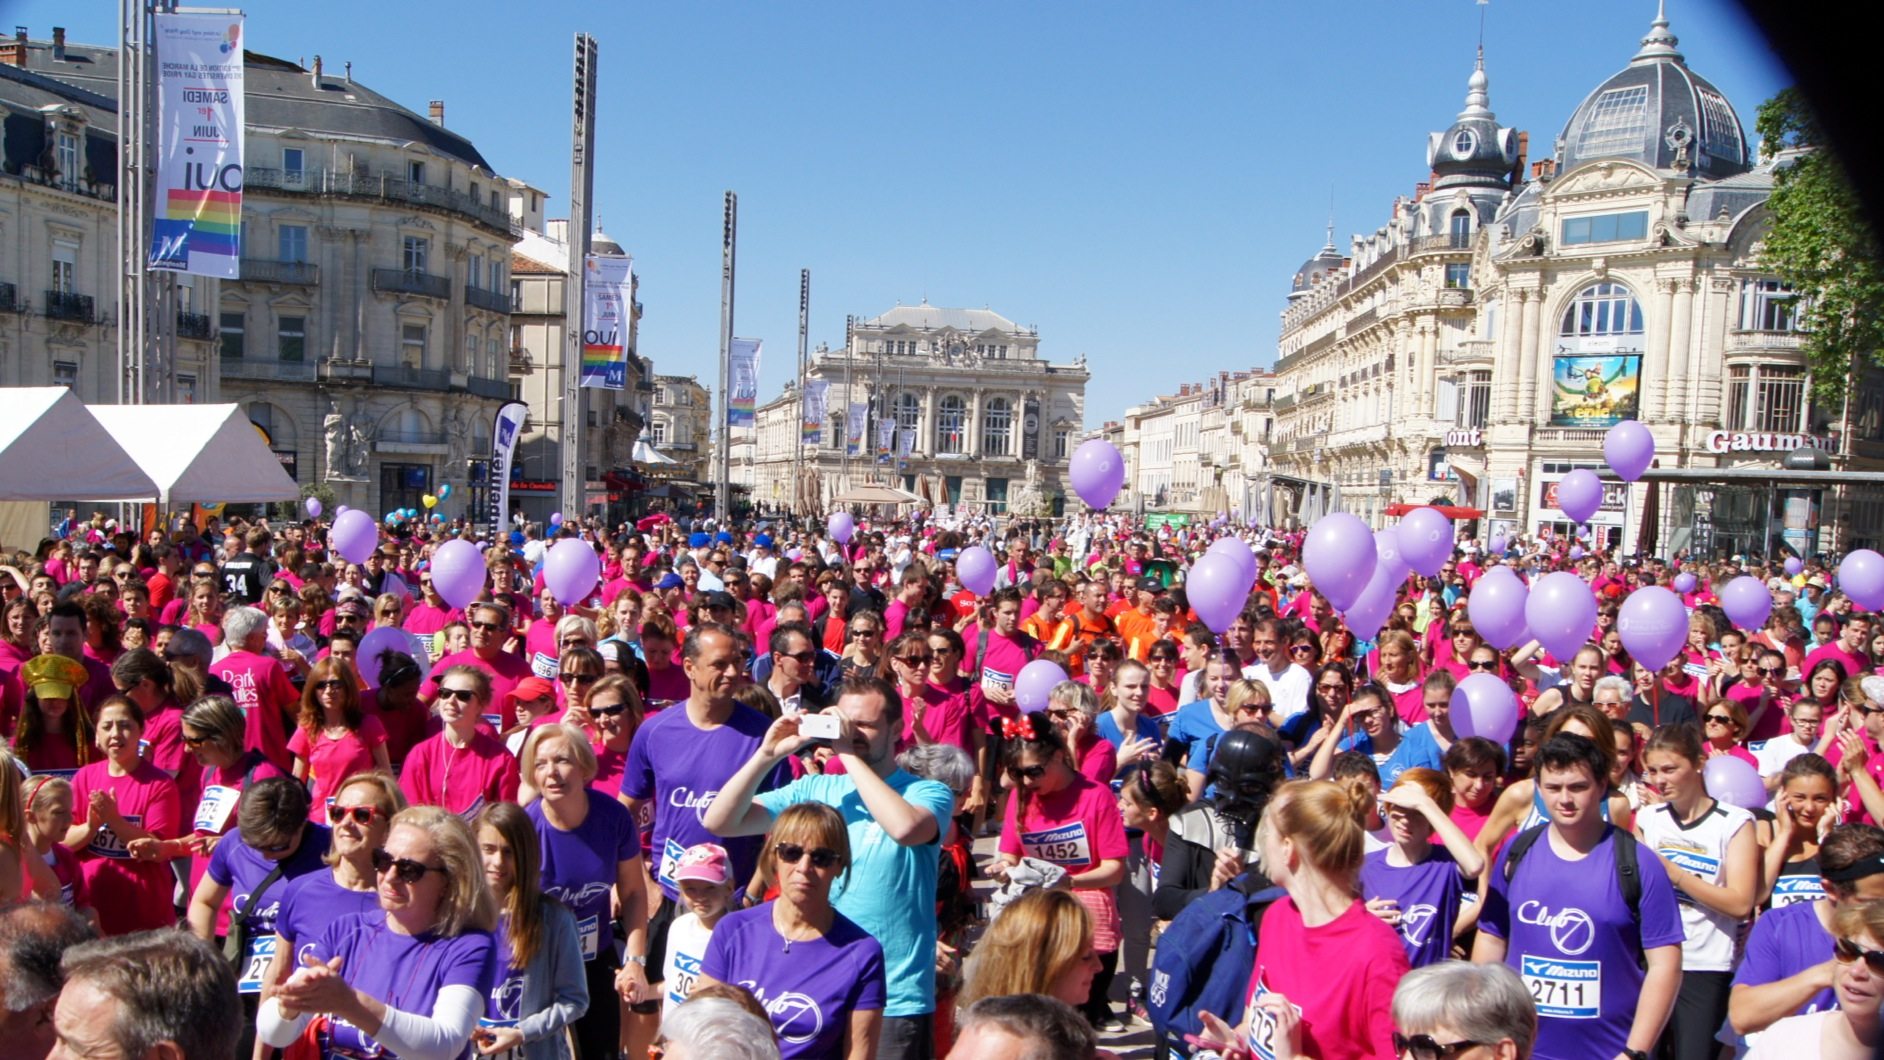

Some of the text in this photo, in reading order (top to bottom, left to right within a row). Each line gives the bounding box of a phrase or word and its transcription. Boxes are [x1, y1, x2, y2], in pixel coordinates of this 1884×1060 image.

[1444, 426, 1481, 447] ont
[1601, 486, 1626, 504] ick
[226, 574, 248, 596] 34
[1034, 841, 1080, 859] 1452
[1517, 900, 1568, 928] Club
[1532, 979, 1583, 1006] 2711
